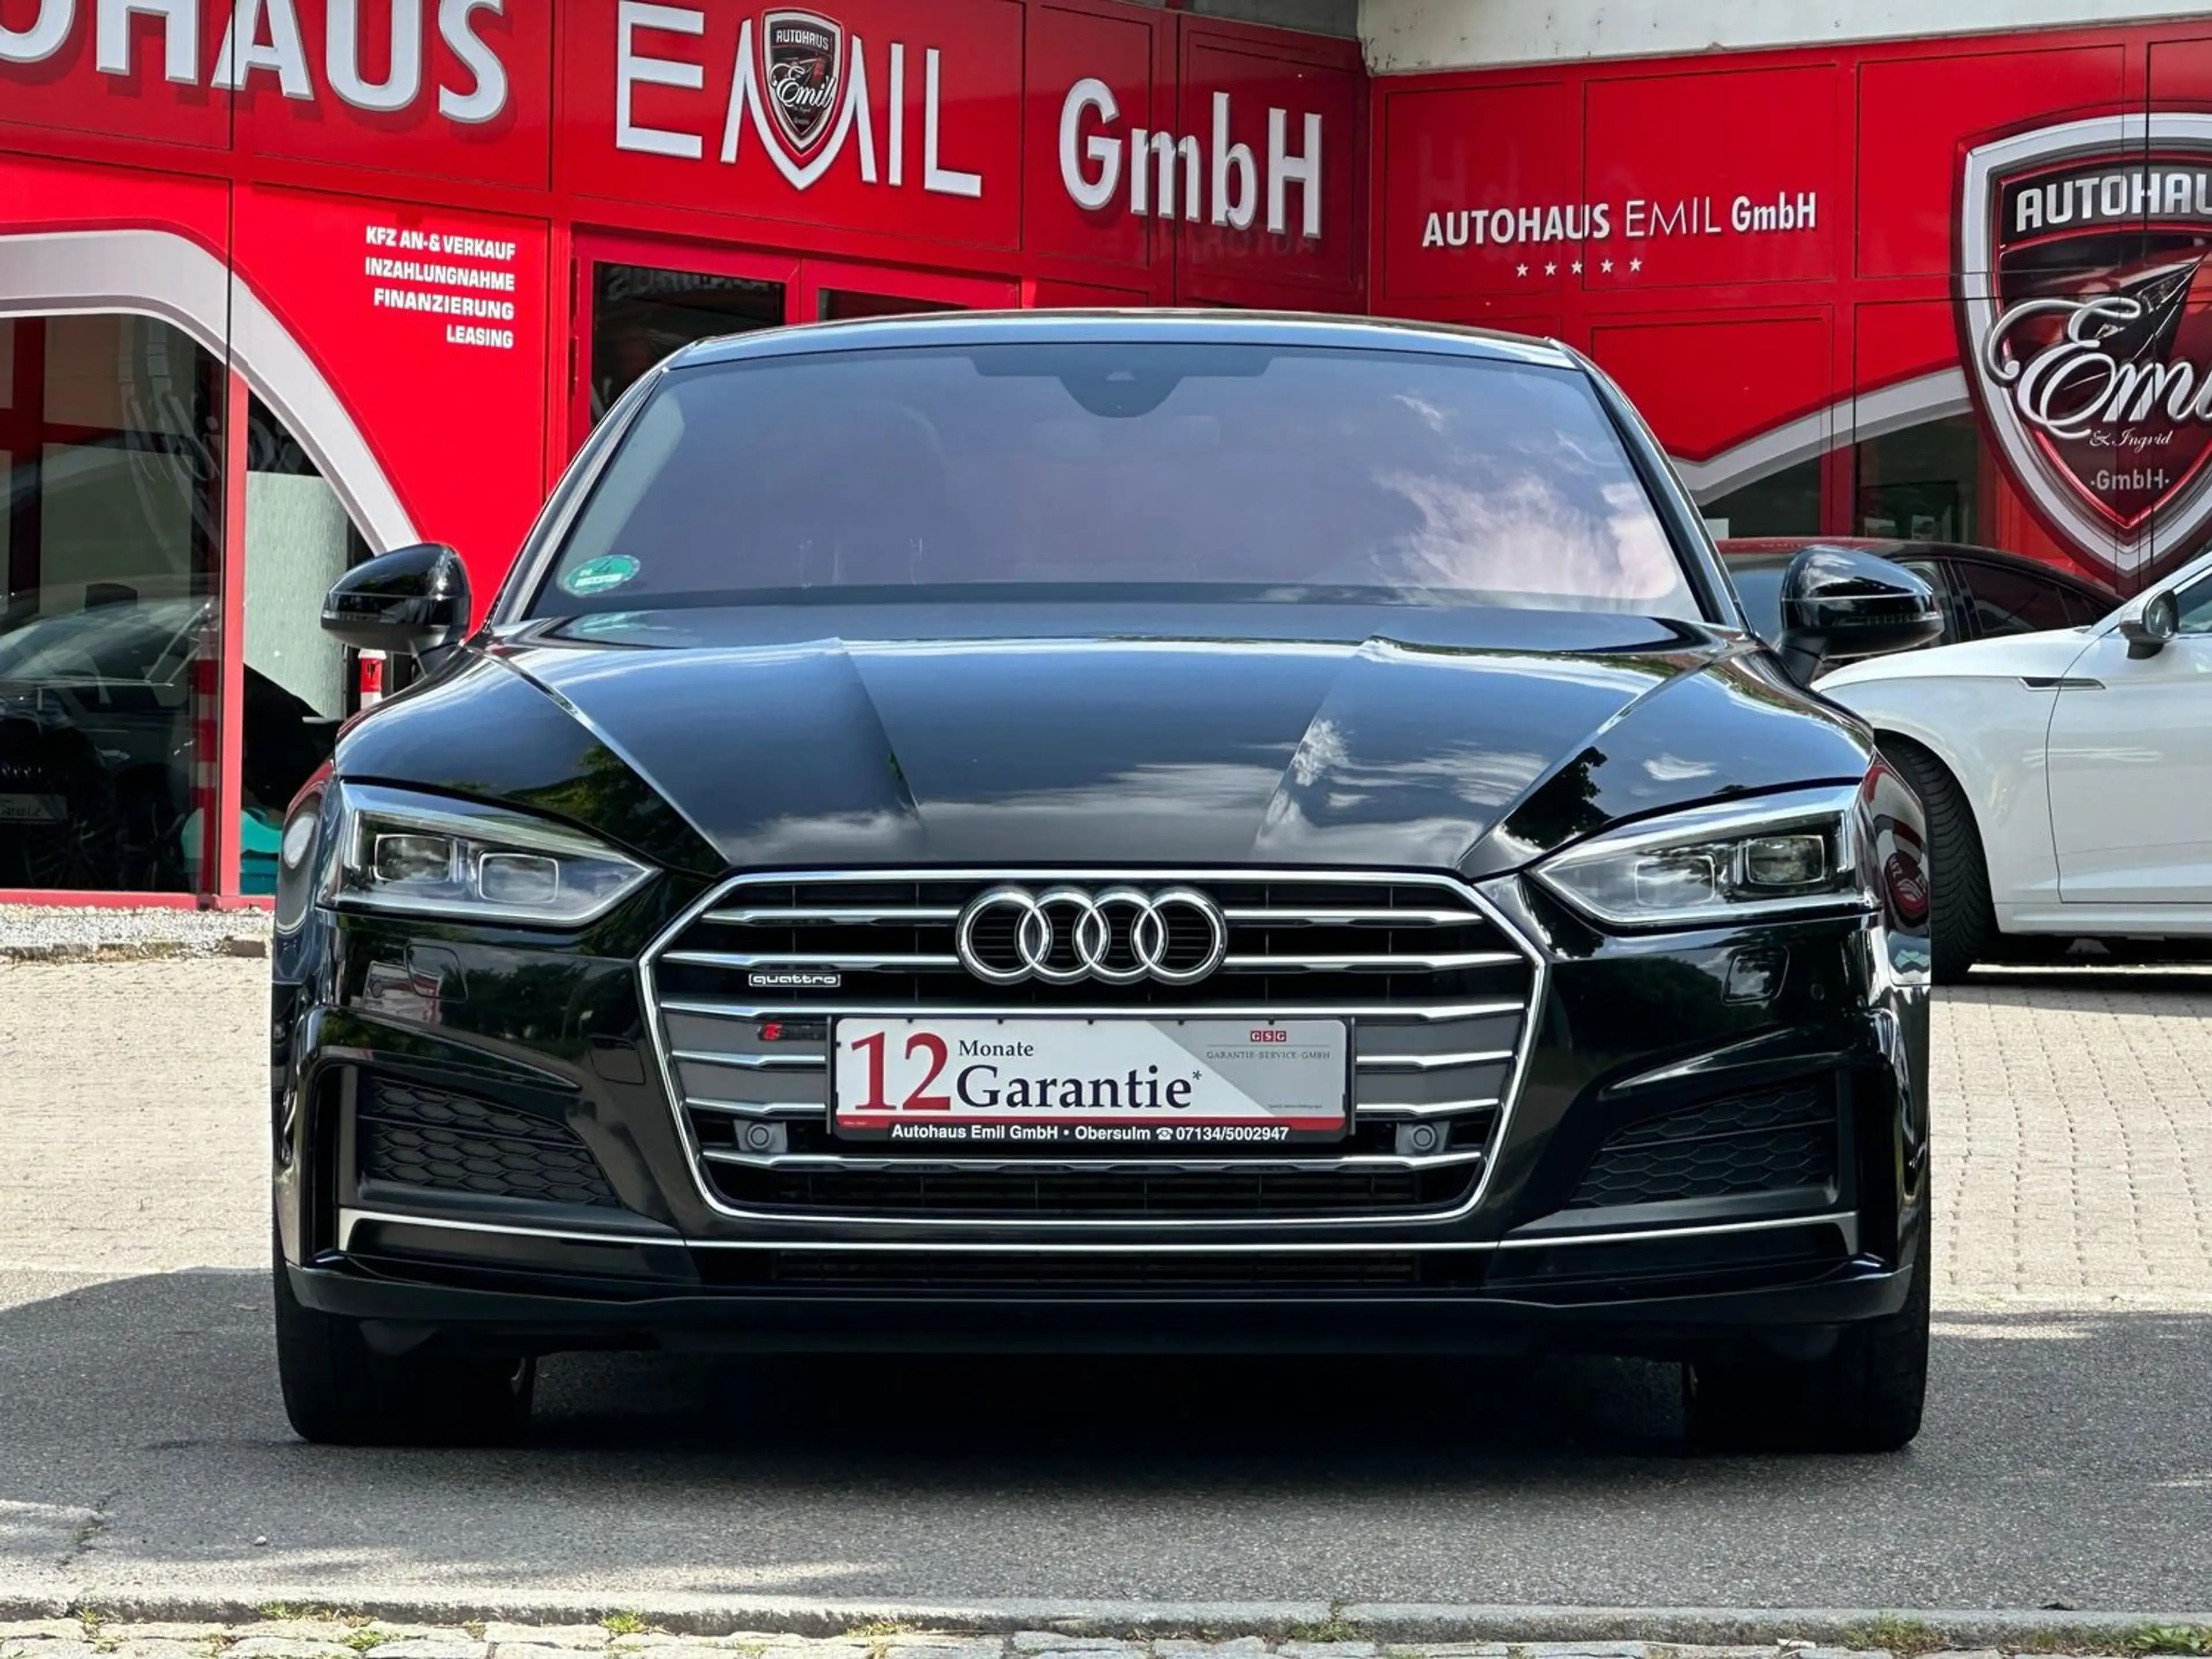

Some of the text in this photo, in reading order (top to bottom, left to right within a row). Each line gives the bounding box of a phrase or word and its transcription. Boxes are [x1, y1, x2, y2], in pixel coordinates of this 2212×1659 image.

[775, 29, 829, 50] AUTOHAUS
[770, 63, 836, 109] Emil
[616, 0, 982, 198] EMIL
[1059, 78, 1321, 239] GmbH
[1422, 191, 1817, 247] AUTOHAUS EMIL GmbH
[365, 225, 397, 247] KFZ
[442, 234, 516, 261] VERKAUF
[365, 256, 516, 291] INZAHLUNGNAHME
[373, 287, 514, 321] FINANZIERUNG
[446, 323, 514, 349] LEASING
[2089, 427, 2174, 454] & Ingrid
[753, 974, 836, 985] quattro
[959, 1039, 1034, 1056] Monate
[1251, 1031, 1287, 1042] GSG
[850, 1031, 951, 1111] 12
[892, 1124, 1290, 1141] Autohaus Emil GmbH Obersulm 07134/5002947
